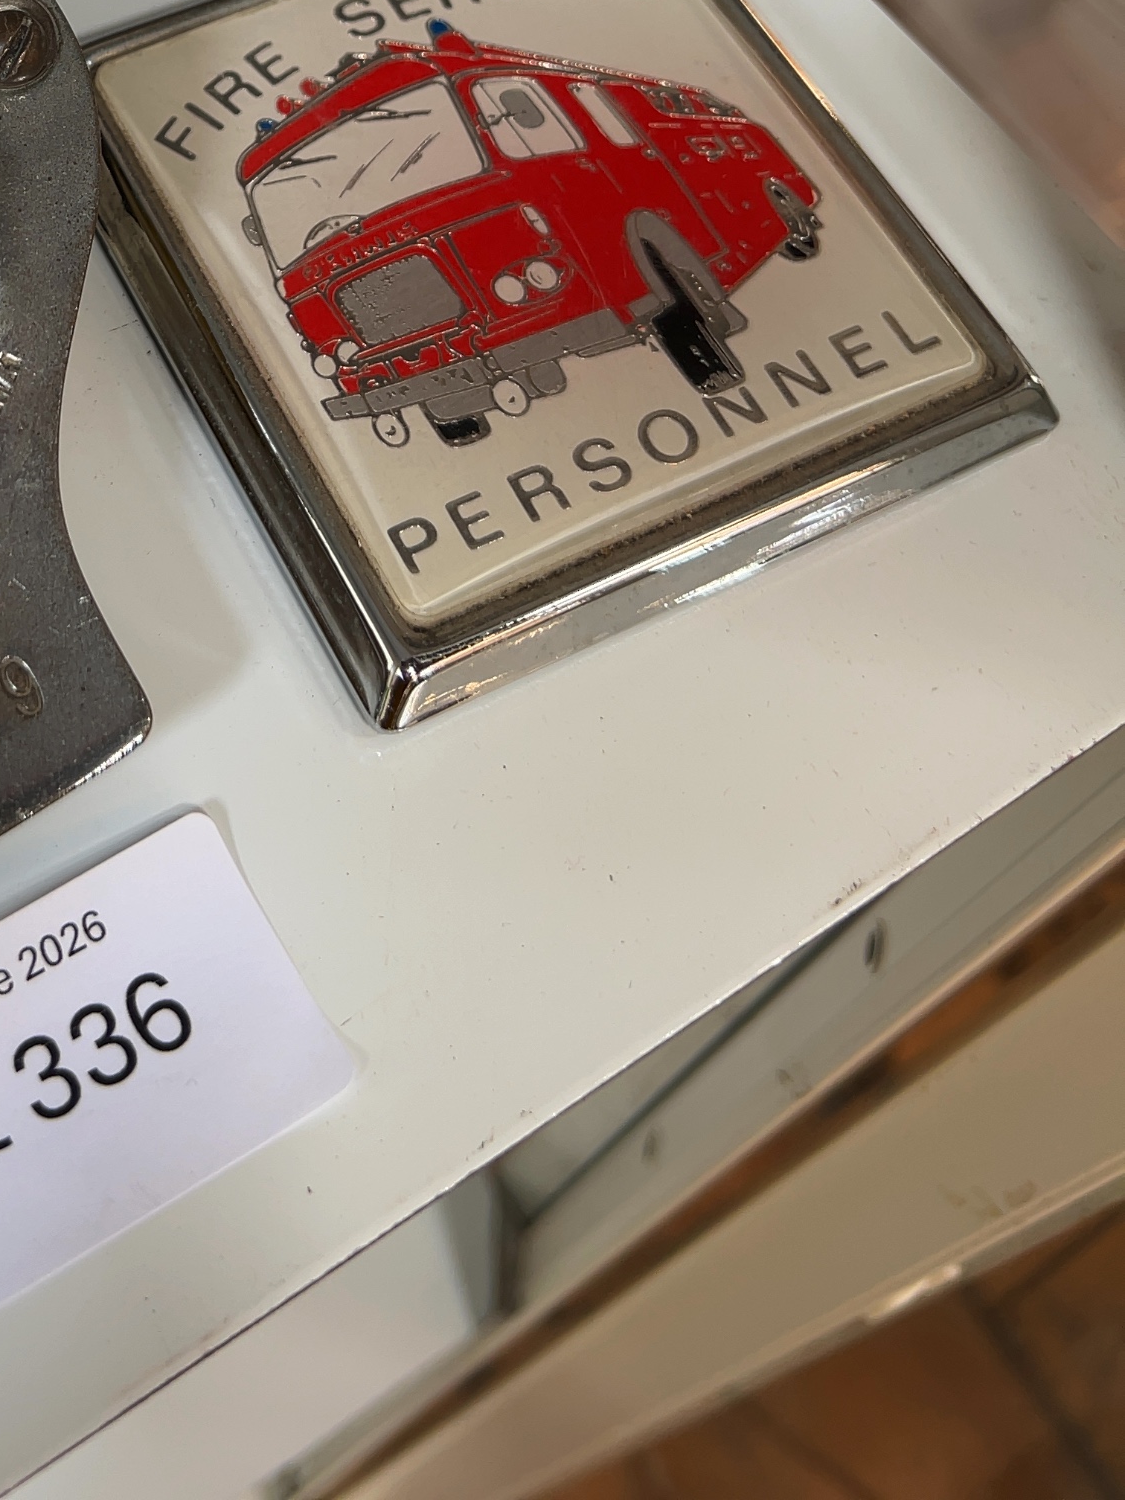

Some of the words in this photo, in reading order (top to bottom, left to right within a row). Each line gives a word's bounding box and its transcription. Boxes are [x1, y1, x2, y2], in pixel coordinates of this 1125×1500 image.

[155, 41, 300, 162] FIRE
[386, 308, 943, 575] PERSONNEL
[18, 910, 107, 982] 2026
[13, 972, 192, 1120] 336
